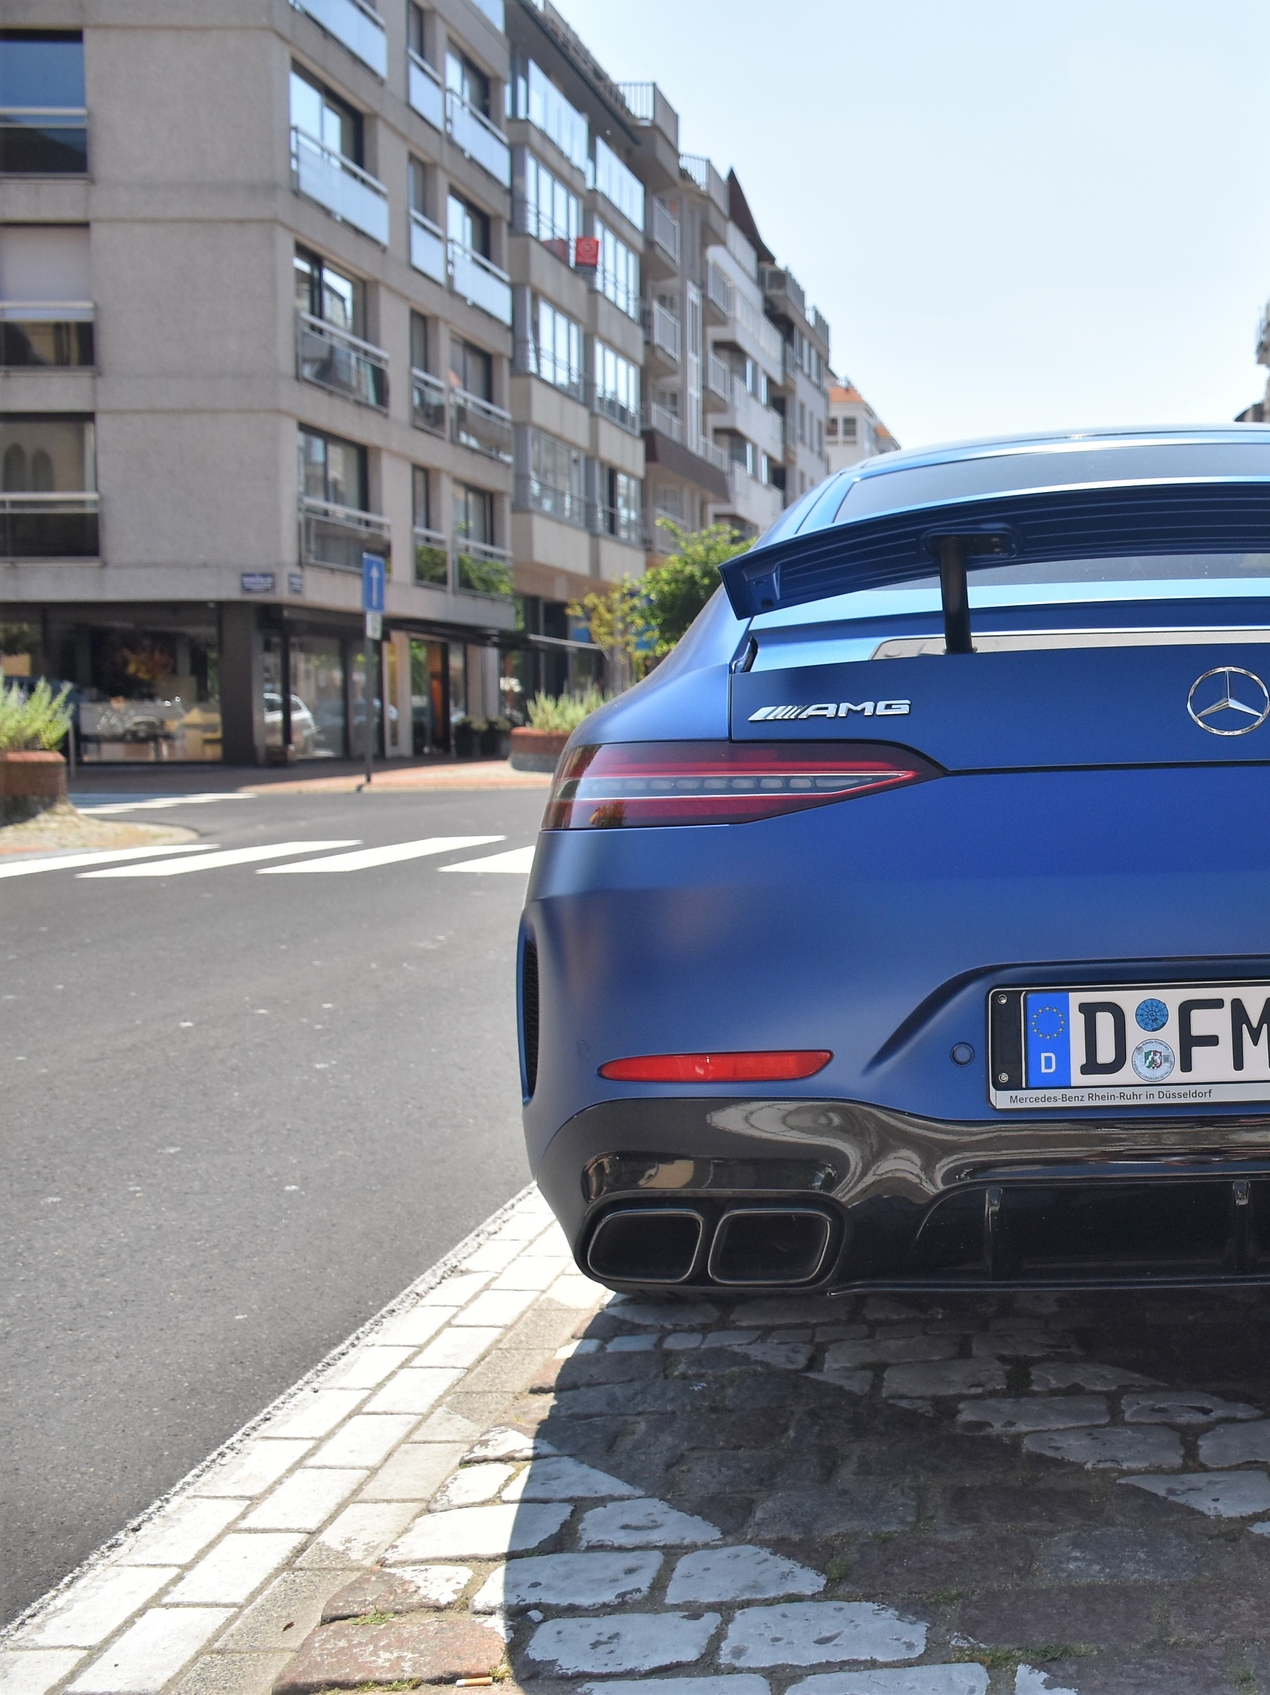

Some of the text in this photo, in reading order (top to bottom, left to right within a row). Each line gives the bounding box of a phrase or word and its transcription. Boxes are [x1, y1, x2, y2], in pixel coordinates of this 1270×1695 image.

[799, 699, 911, 719] AMG
[1078, 1001, 1127, 1075] D
[1041, 1053, 1056, 1074] D
[1009, 1088, 1213, 1105] Mercedes-Benz Rhein-Ruhr in Düsseldorf
